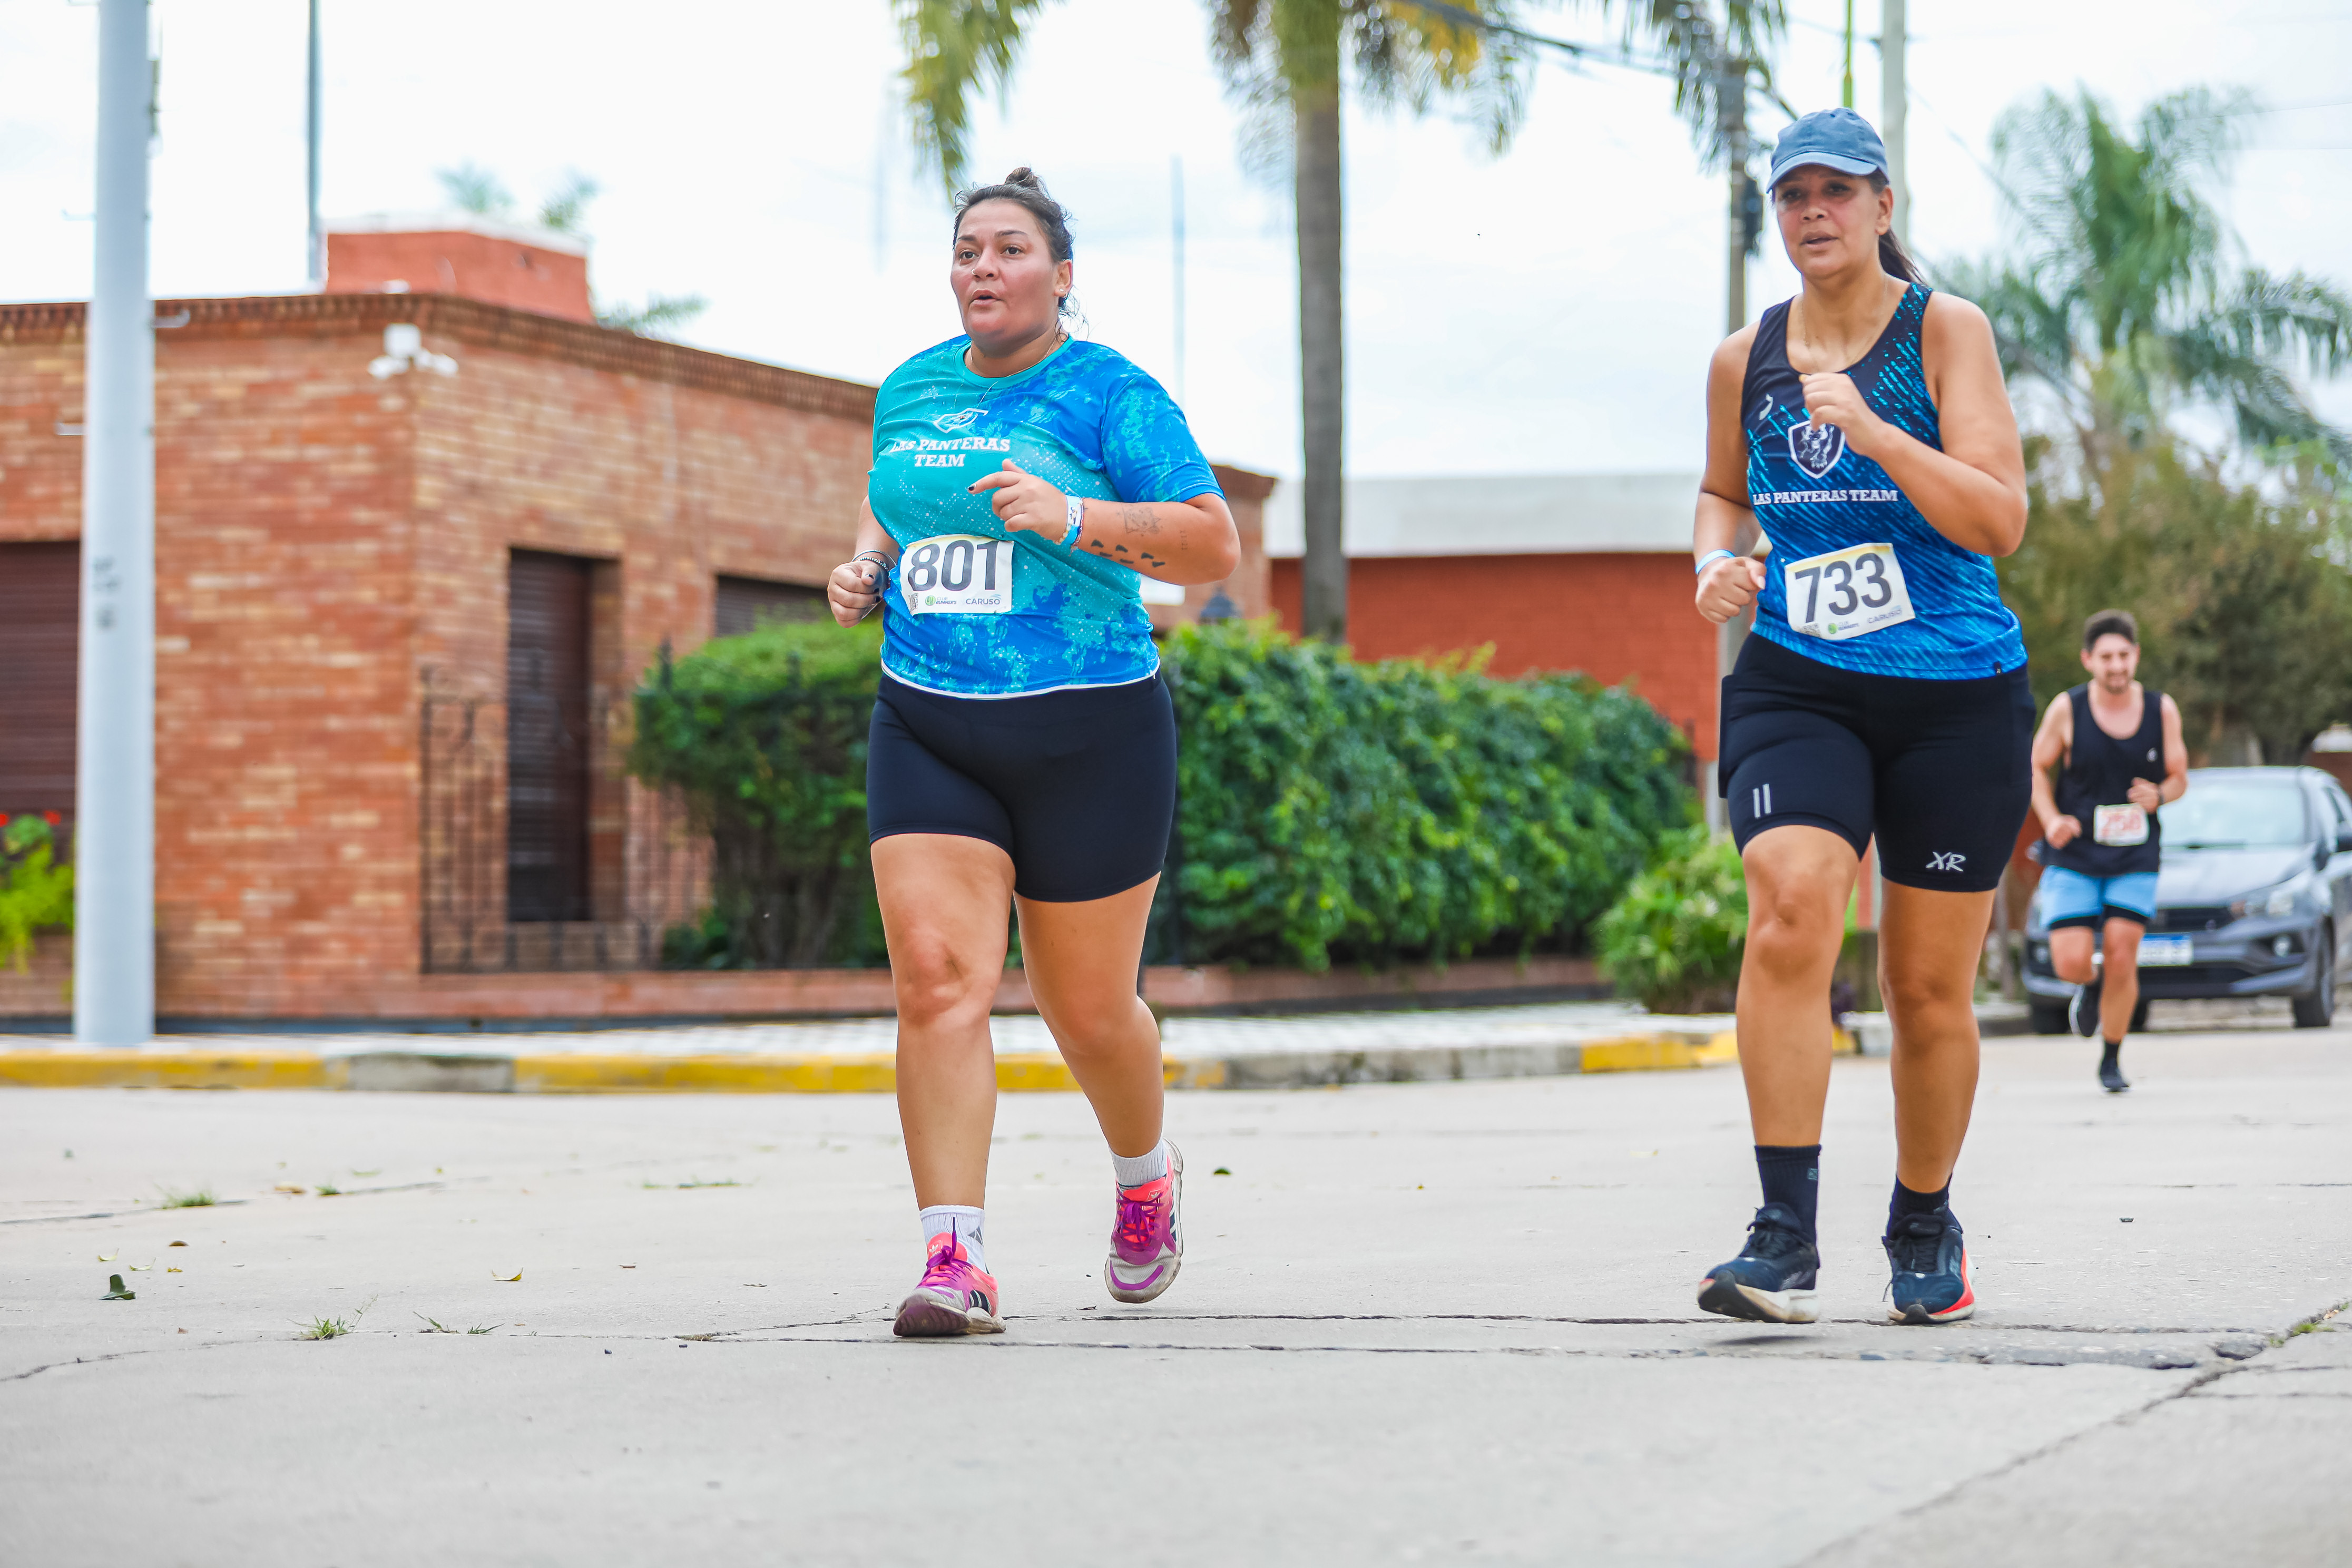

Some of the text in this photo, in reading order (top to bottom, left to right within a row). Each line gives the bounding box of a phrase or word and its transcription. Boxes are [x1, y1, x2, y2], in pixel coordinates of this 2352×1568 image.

[889, 437, 1010, 453] LAS PANTERAS
[914, 454, 966, 467] TEAM
[1753, 489, 1898, 505] LAS PANTERAS TEAM
[908, 540, 999, 591] 801
[1795, 552, 1892, 623] 733
[1925, 851, 1966, 871] XR
